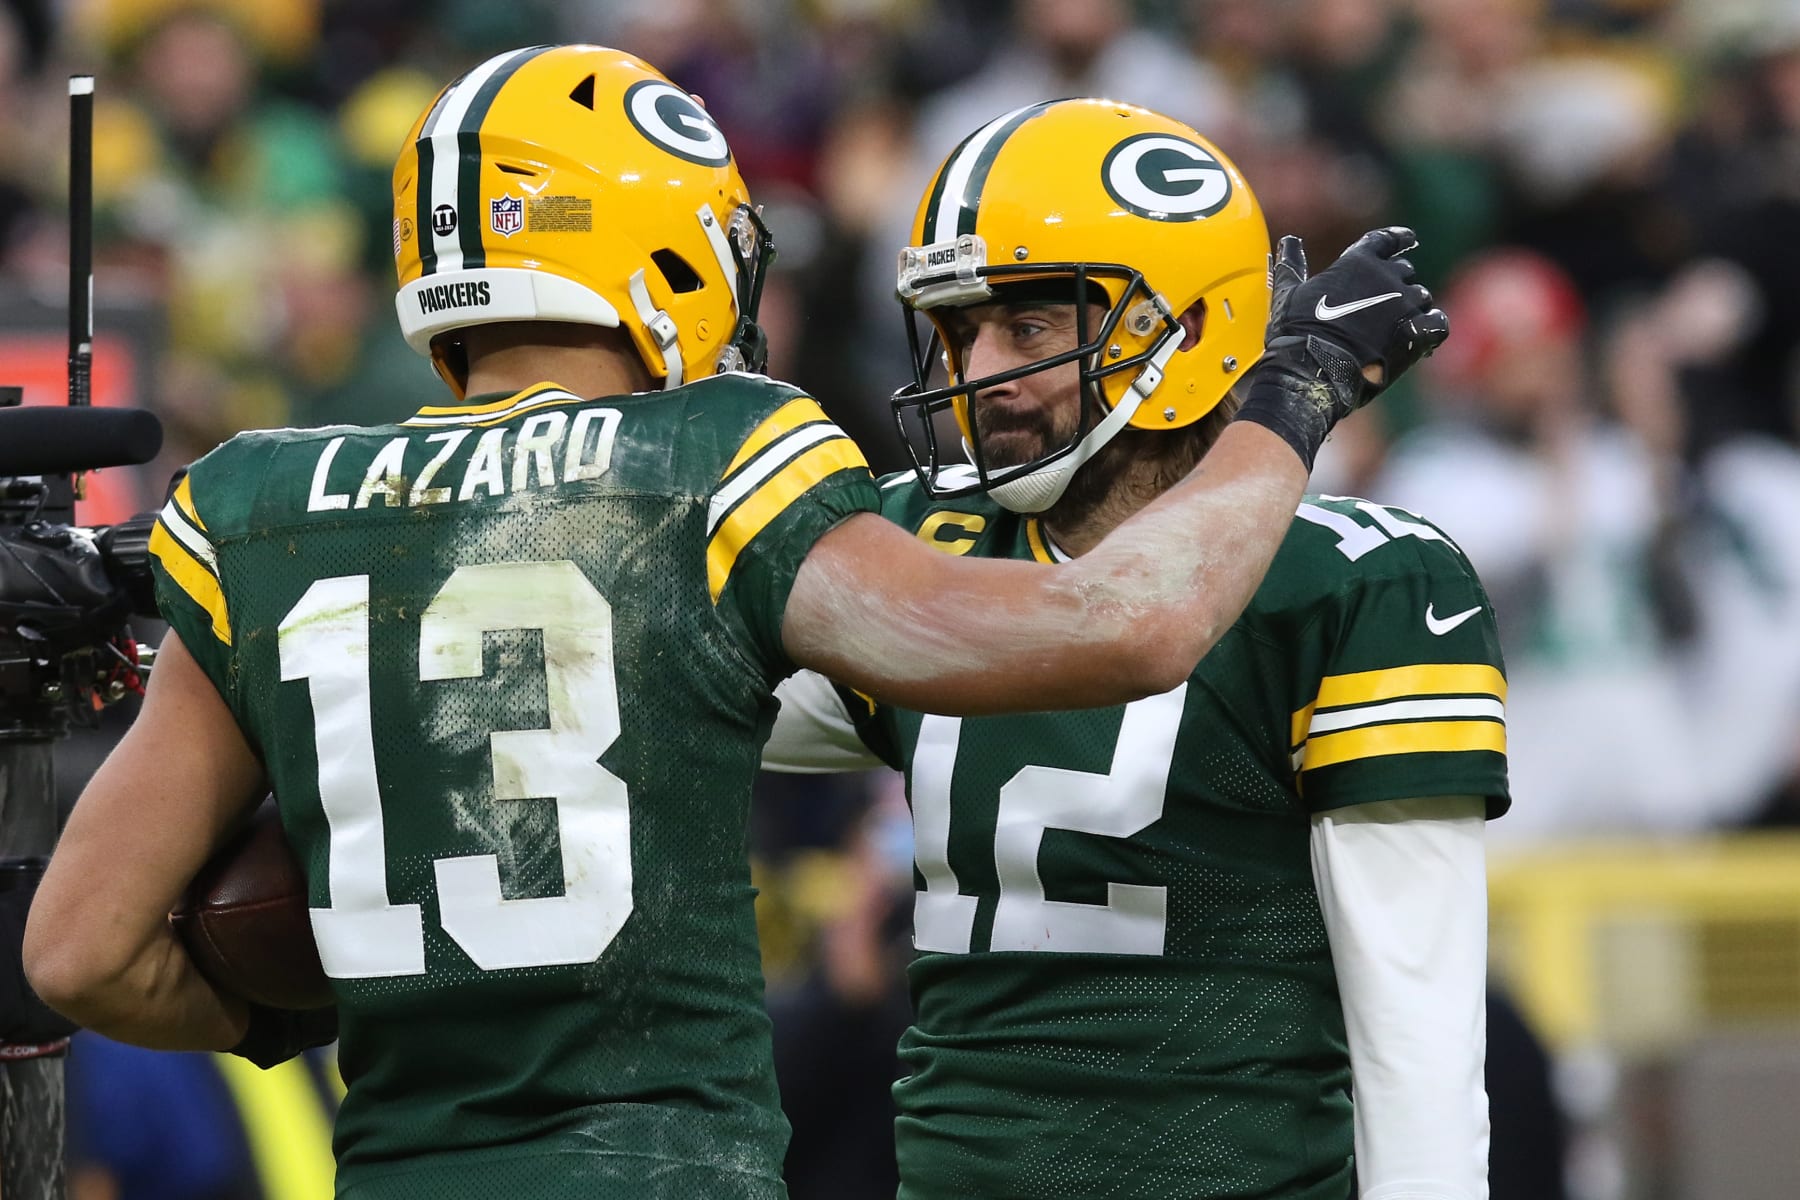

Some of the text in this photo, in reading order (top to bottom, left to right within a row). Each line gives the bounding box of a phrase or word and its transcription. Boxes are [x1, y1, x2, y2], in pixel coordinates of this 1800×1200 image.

[630, 84, 729, 160] G
[1109, 137, 1228, 214] G
[434, 209, 453, 226] TT
[494, 213, 519, 230] NFL
[927, 248, 956, 267] PACKER
[417, 281, 491, 315] PACKERS
[306, 407, 623, 513] LAZARD
[916, 510, 986, 556] C
[277, 560, 634, 979] 13
[911, 680, 1188, 957] 12
